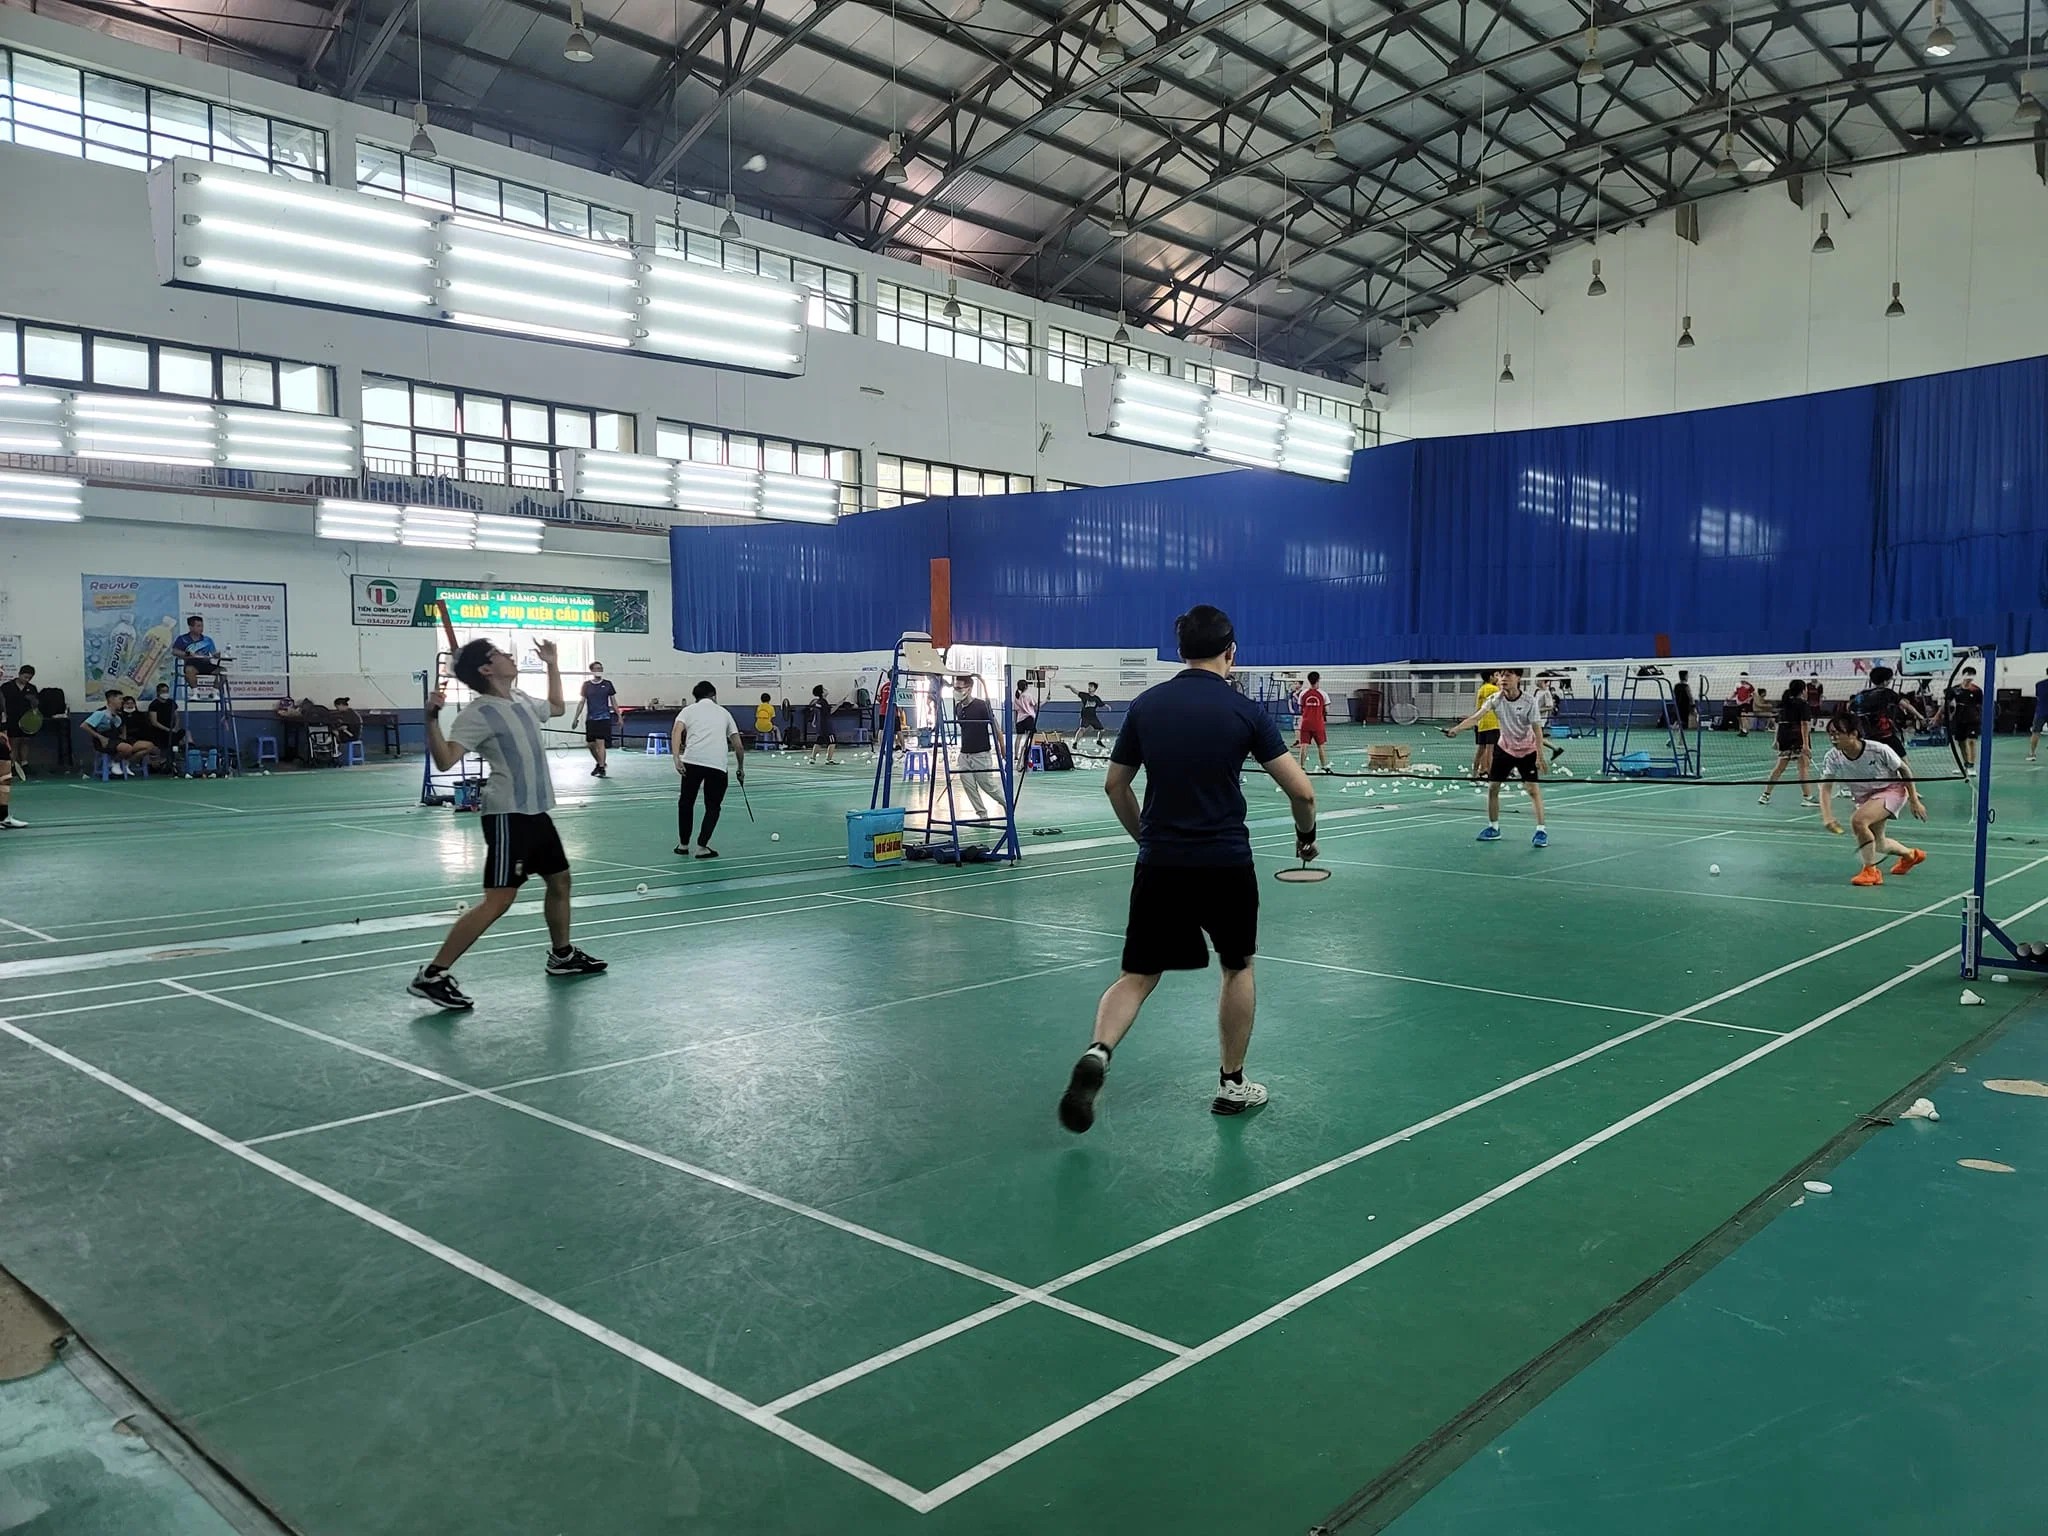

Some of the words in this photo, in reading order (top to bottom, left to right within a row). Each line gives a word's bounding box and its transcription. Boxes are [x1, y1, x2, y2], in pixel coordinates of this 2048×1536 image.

[89, 581, 139, 590] Revive
[189, 591, 215, 600] BẢNG
[218, 592, 234, 601] GIÁ
[237, 594, 260, 603] DỊCH
[263, 595, 275, 604] VỤ
[440, 592, 478, 600] CHUYÊN
[511, 593, 537, 602] HÀNG
[539, 595, 568, 605] CHÍNH
[569, 597, 595, 606] HÃNG
[527, 607, 553, 621] KIỆN
[108, 635, 125, 676] Revive
[1909, 649, 1944, 662] SÂN7
